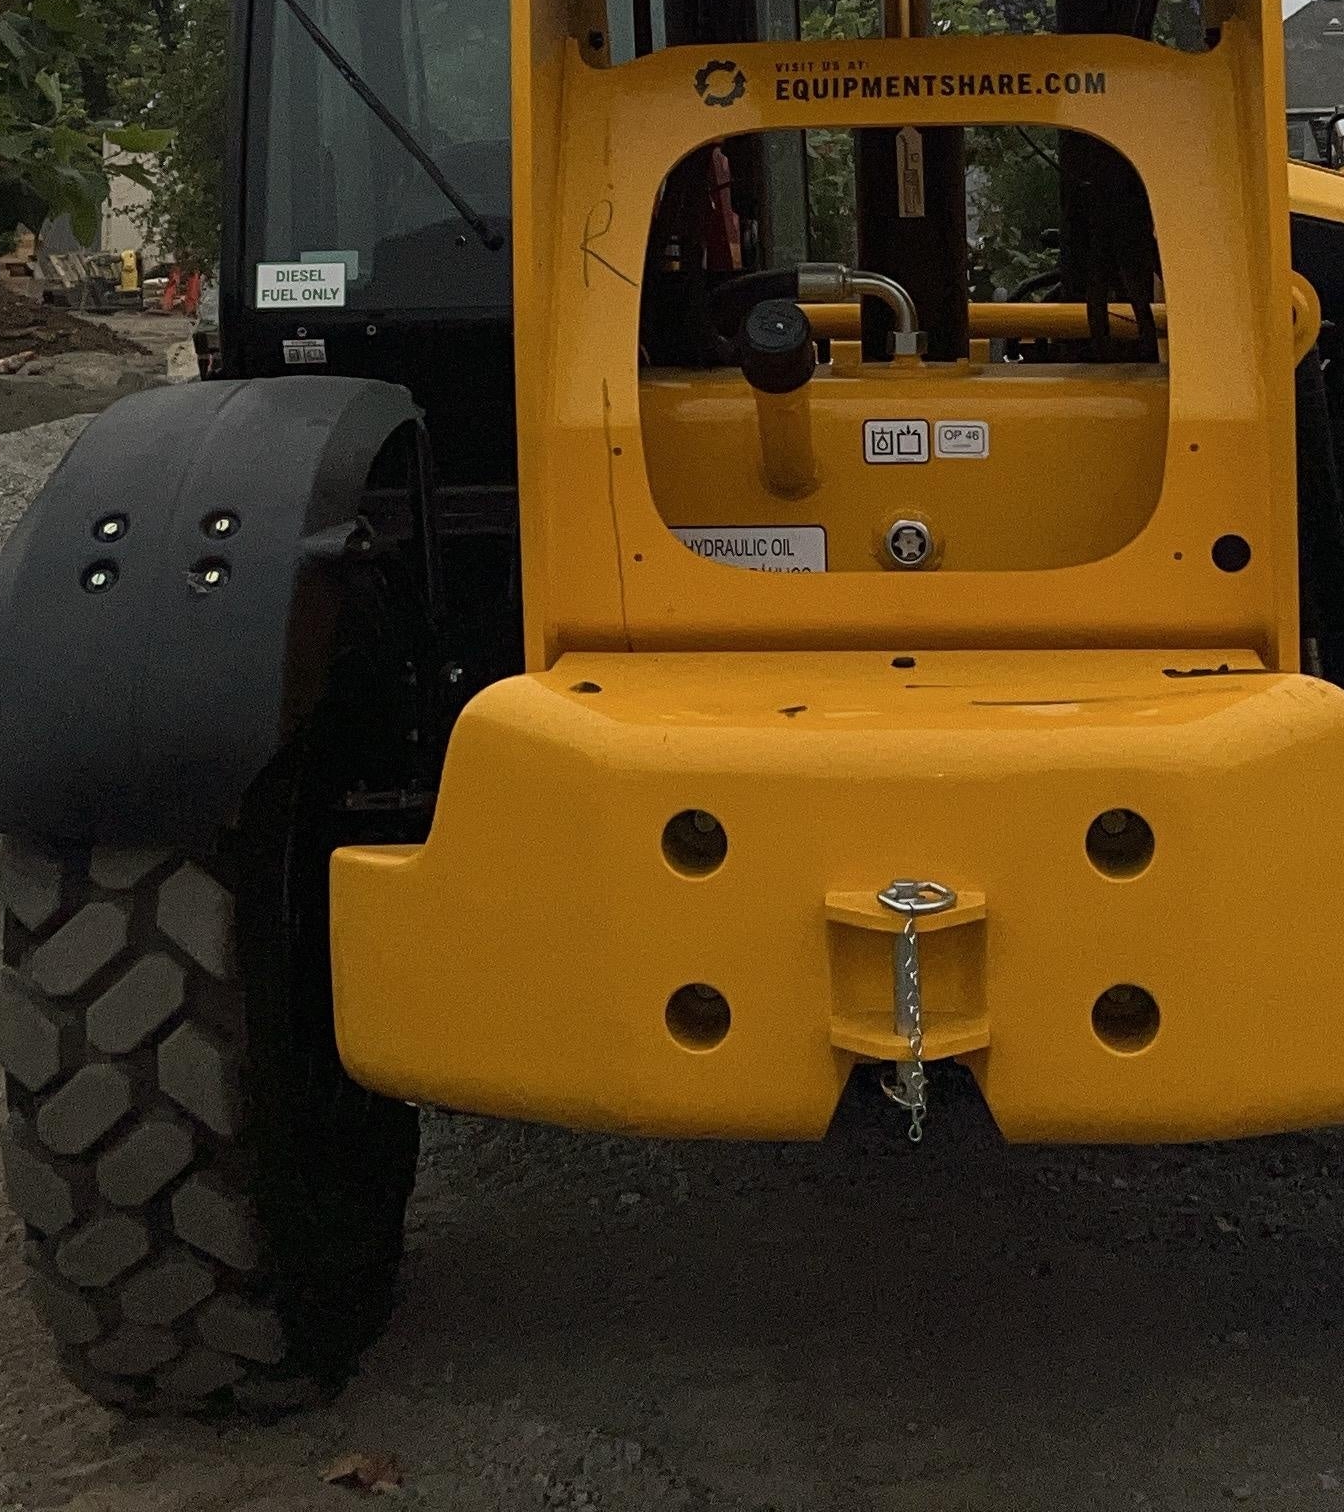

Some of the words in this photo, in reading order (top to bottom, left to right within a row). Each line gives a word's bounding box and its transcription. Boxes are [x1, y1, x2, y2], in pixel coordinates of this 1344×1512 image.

[775, 62, 814, 73] VISIT
[822, 61, 840, 71] US
[775, 72, 1106, 102] EQUIPMENTSHARE.COM
[276, 269, 325, 282] DIESEL
[261, 289, 298, 302] FUEL
[301, 287, 340, 301] ONLY
[944, 429, 962, 441] OP
[965, 430, 980, 441] 46
[683, 538, 767, 557] HYDRAULIC
[771, 538, 795, 556] OIL
